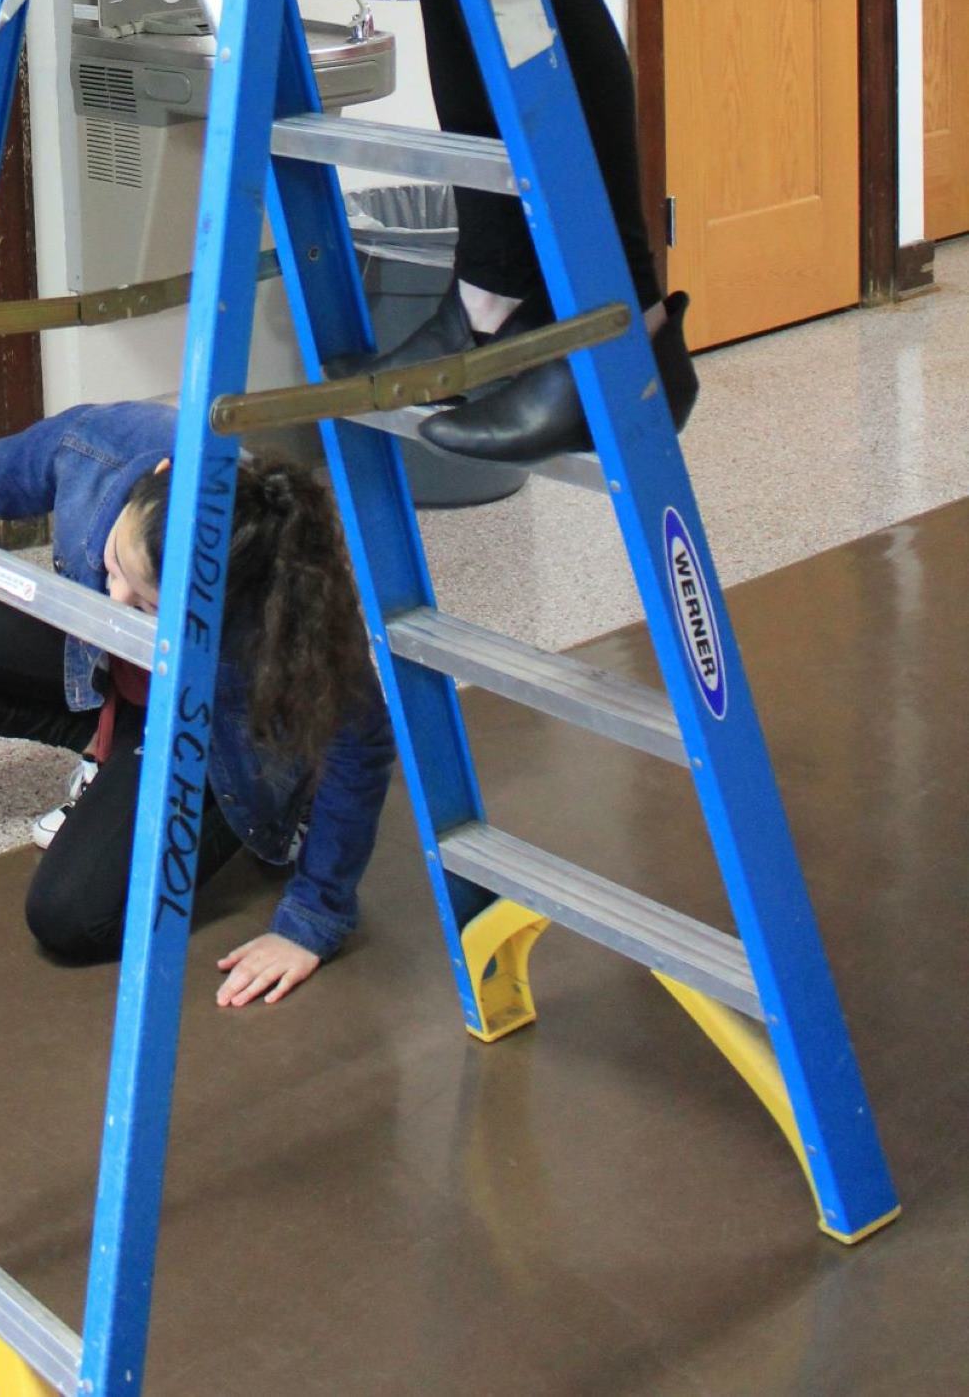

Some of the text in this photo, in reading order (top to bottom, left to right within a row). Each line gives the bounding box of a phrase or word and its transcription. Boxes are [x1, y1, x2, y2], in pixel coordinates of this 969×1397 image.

[152, 457, 236, 932] MIDDLE SCHOOL
[675, 551, 716, 677] WERNER
